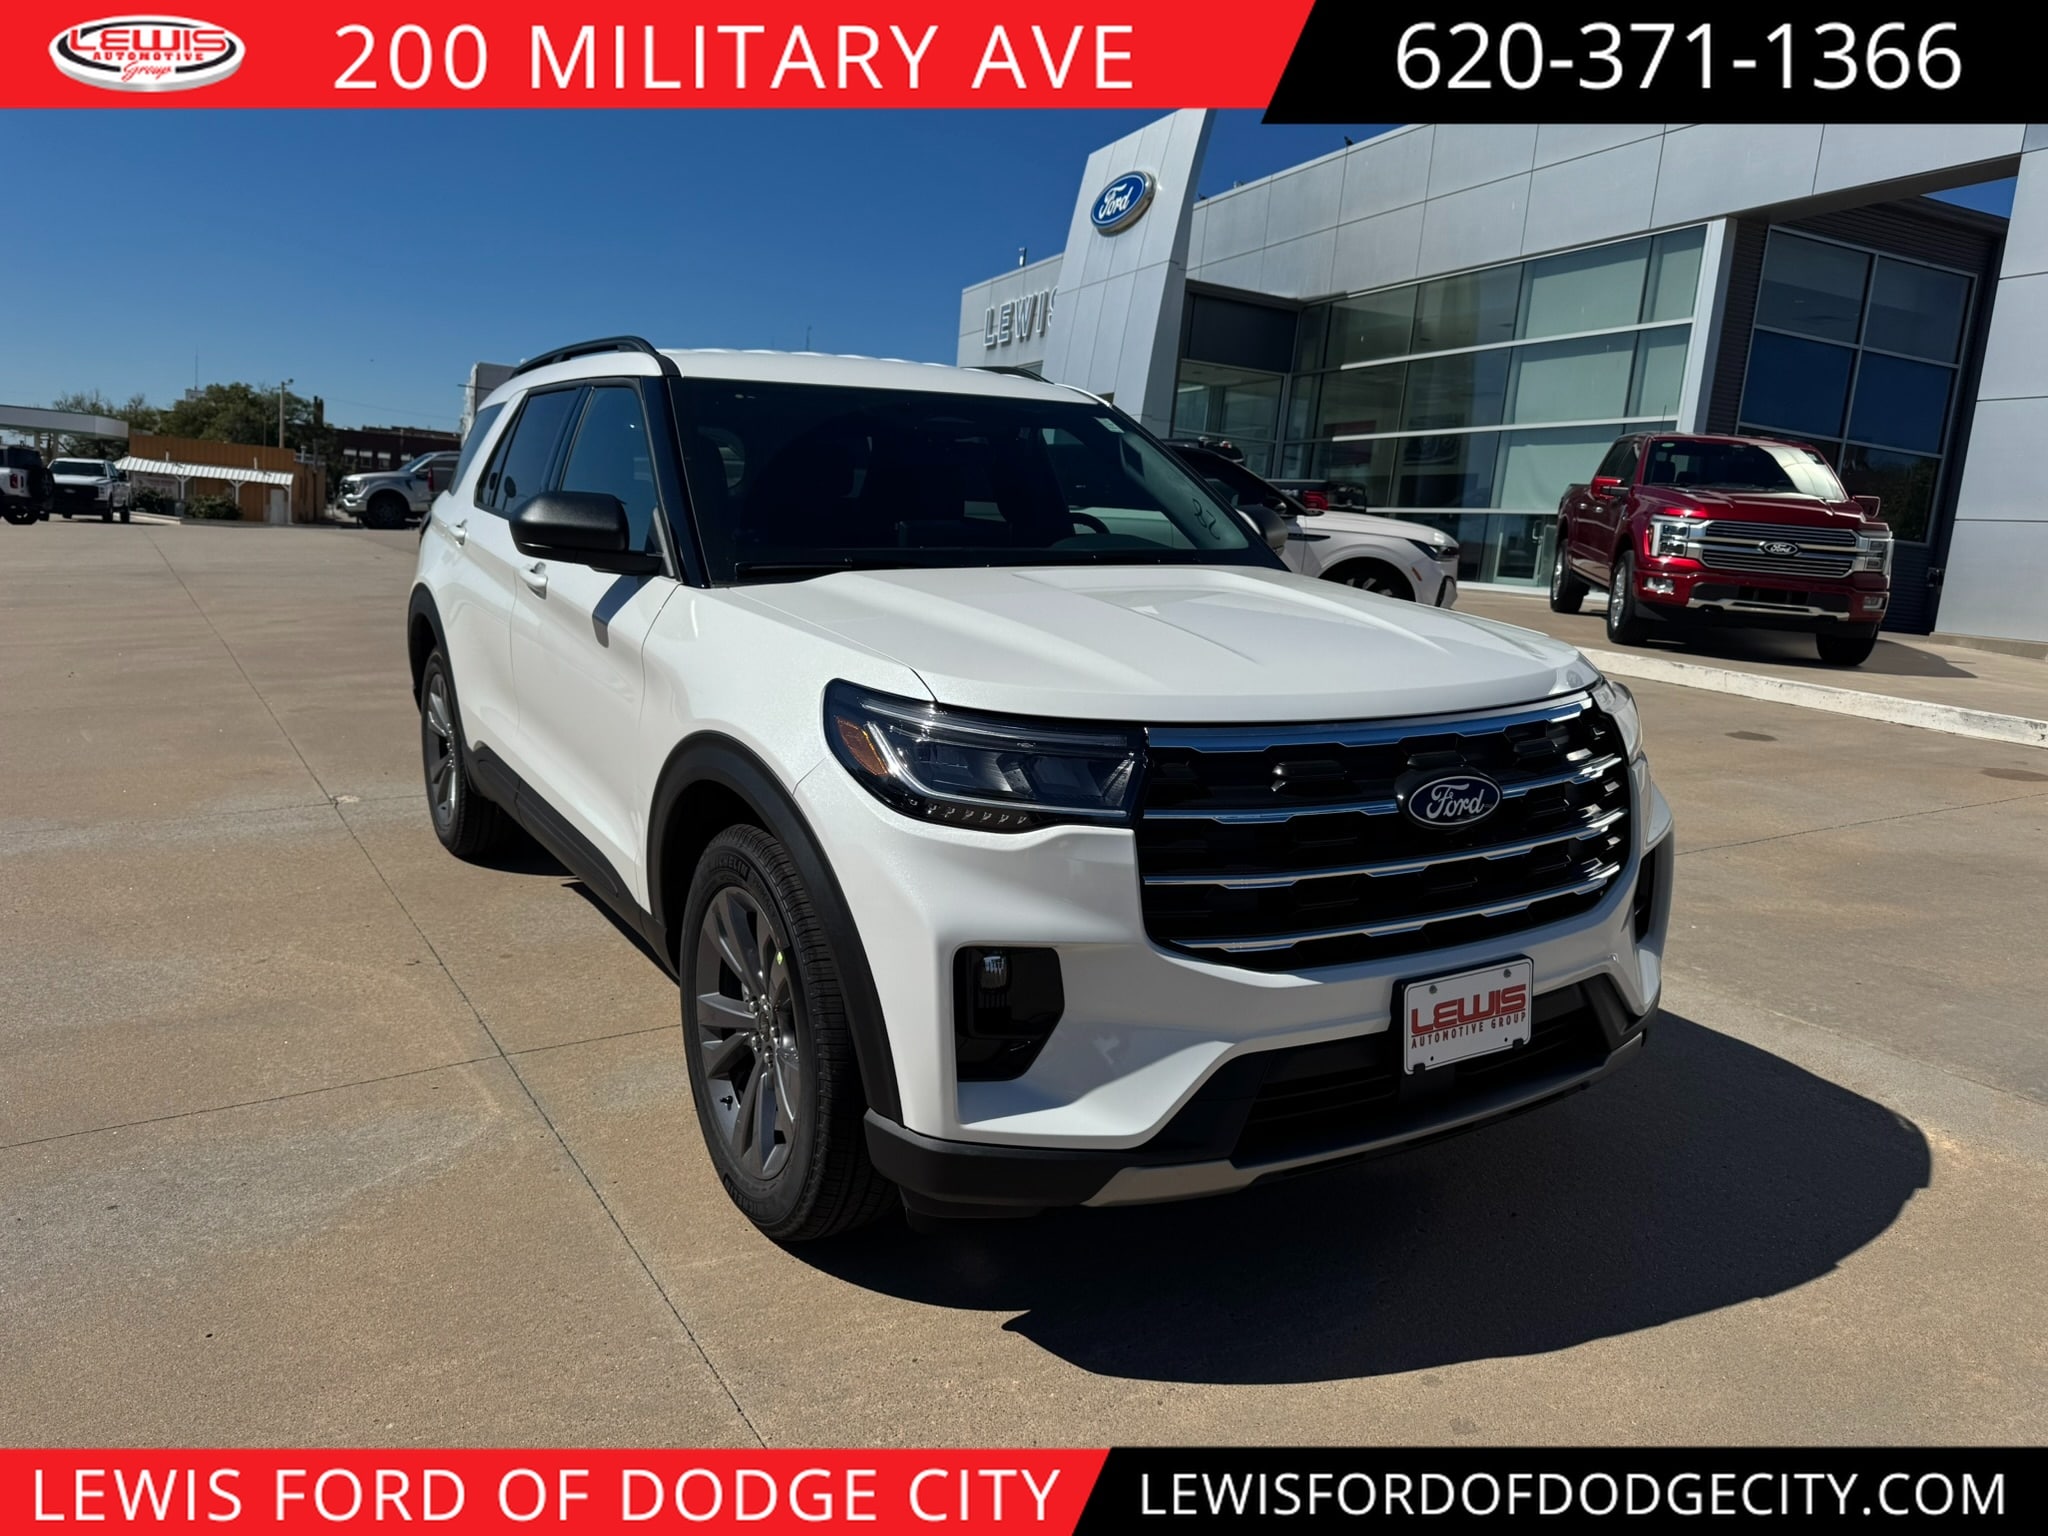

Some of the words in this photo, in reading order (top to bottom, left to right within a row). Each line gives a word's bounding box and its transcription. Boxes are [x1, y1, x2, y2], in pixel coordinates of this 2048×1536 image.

[1098, 183, 1134, 220] Ford
[1426, 783, 1485, 819] Ford
[1411, 983, 1527, 1035] LEWIS
[1411, 1021, 1484, 1049] AUTOMOTIVE
[1490, 1012, 1527, 1029] GROUP
[724, 1177, 765, 1216] ICHELIN
